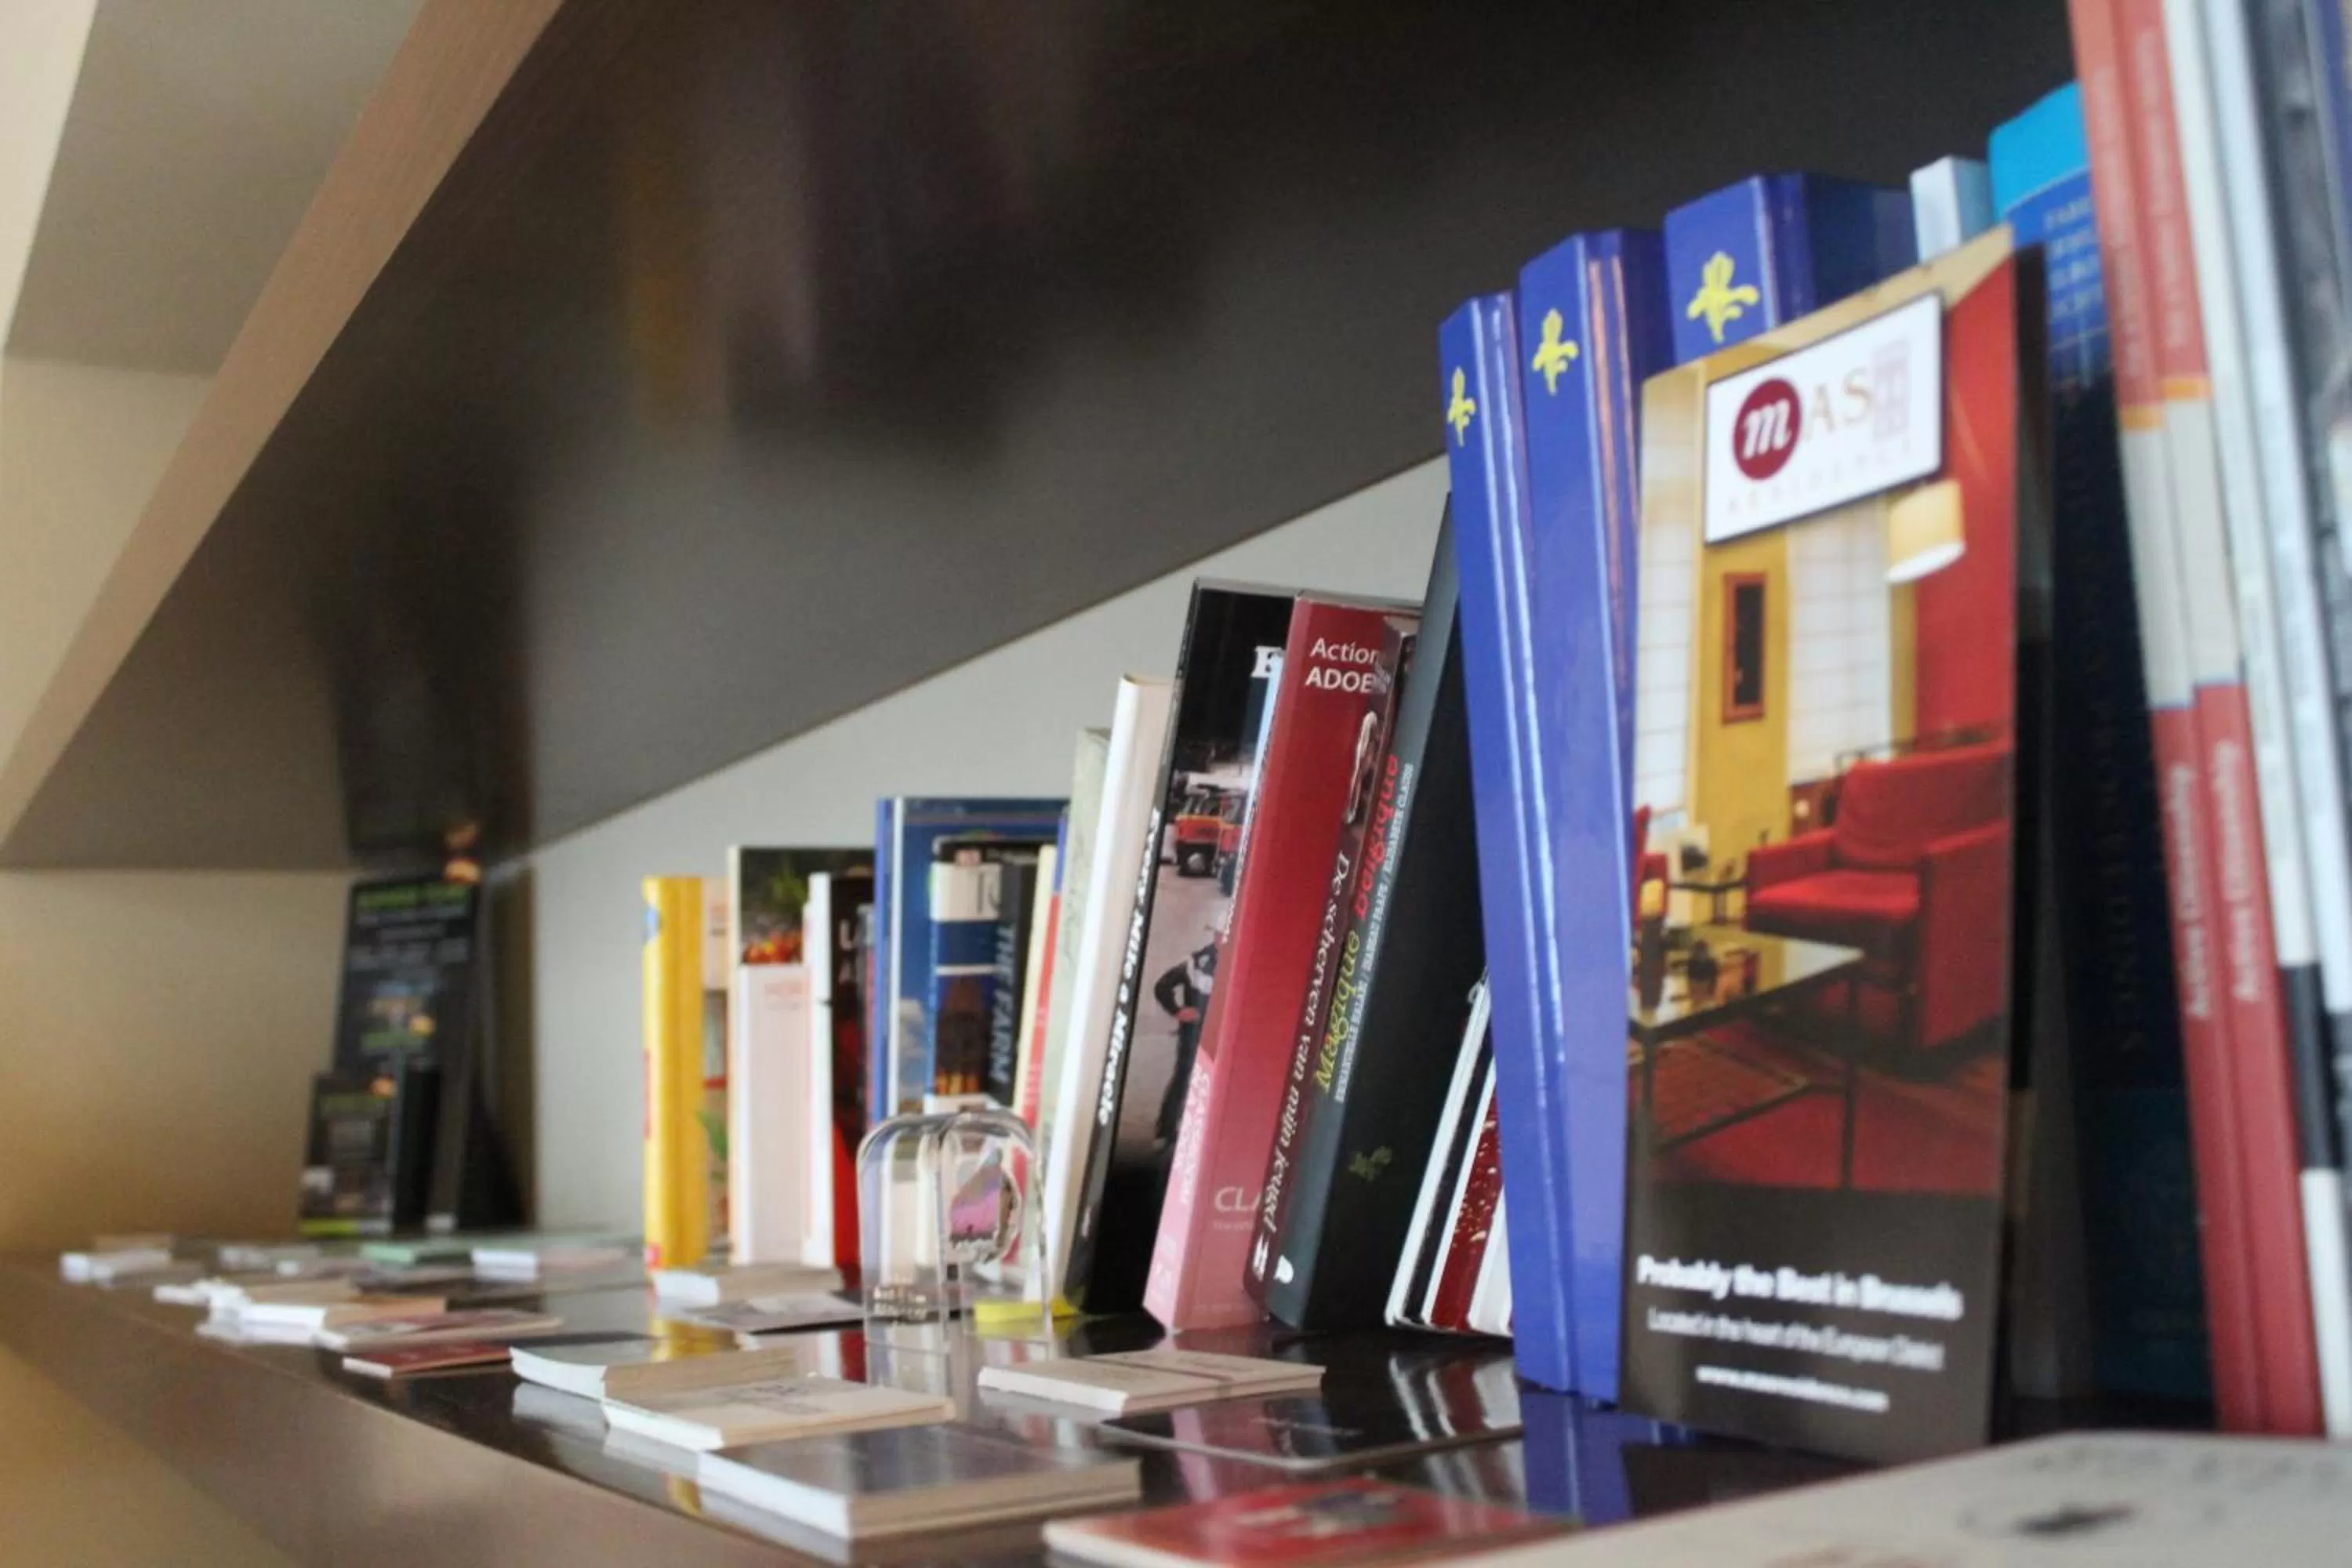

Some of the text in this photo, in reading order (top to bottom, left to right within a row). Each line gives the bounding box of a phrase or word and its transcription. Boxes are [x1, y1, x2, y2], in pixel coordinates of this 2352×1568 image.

[1332, 849, 1350, 896] De
[1123, 907, 1144, 979] Mile
[1315, 930, 1360, 1094] Magique
[1098, 1005, 1127, 1126] Miracle
[1293, 1034, 1311, 1082] van
[1279, 1085, 1299, 1148] mijn
